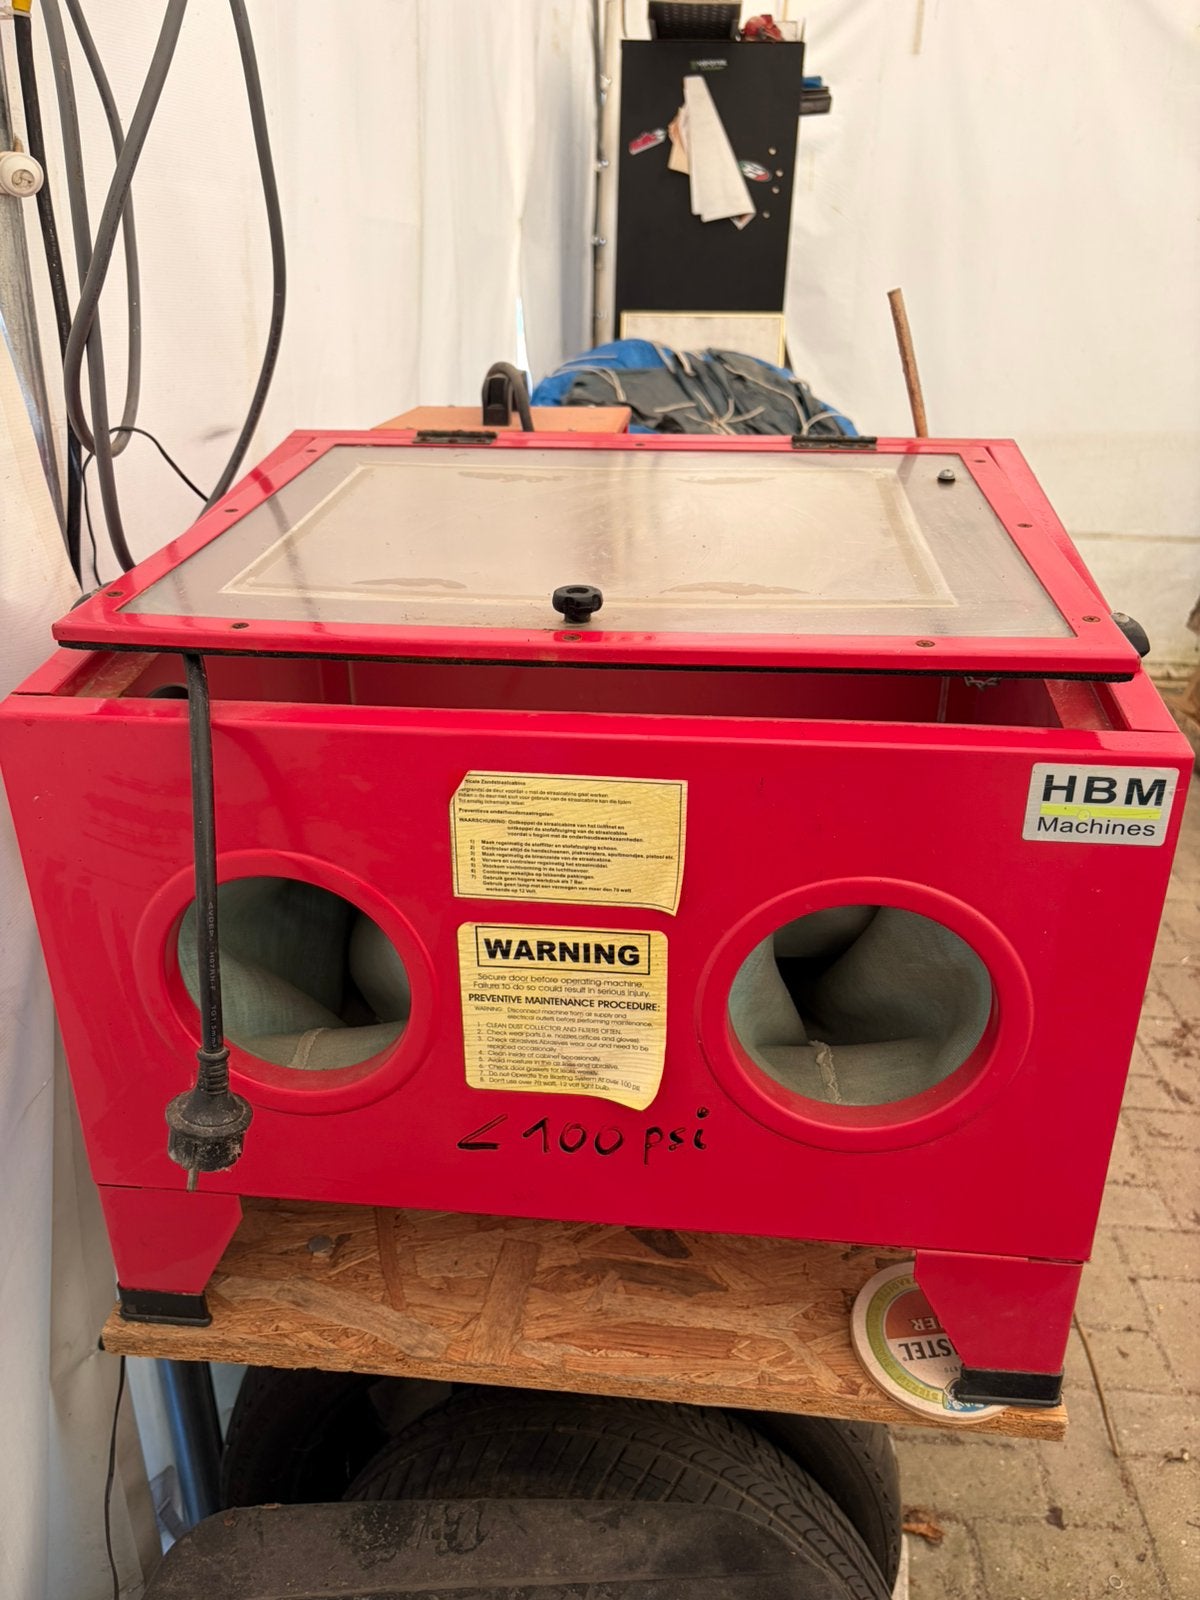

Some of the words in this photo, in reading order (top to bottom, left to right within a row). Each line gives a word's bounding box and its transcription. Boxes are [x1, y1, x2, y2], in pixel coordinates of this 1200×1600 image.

[1042, 775, 1166, 806] HBM
[1037, 816, 1156, 836] Machines
[484, 938, 640, 966] WARNING
[561, 978, 601, 987] operating
[469, 994, 522, 1003] PREVENTIVE
[525, 996, 595, 1008] MAINTENANCE
[598, 1000, 660, 1011] PROCEDURE:
[628, 990, 650, 998] injury.
[621, 1079, 631, 1088] 100
[523, 1117, 624, 1156] 100
[644, 1106, 709, 1166] psi
